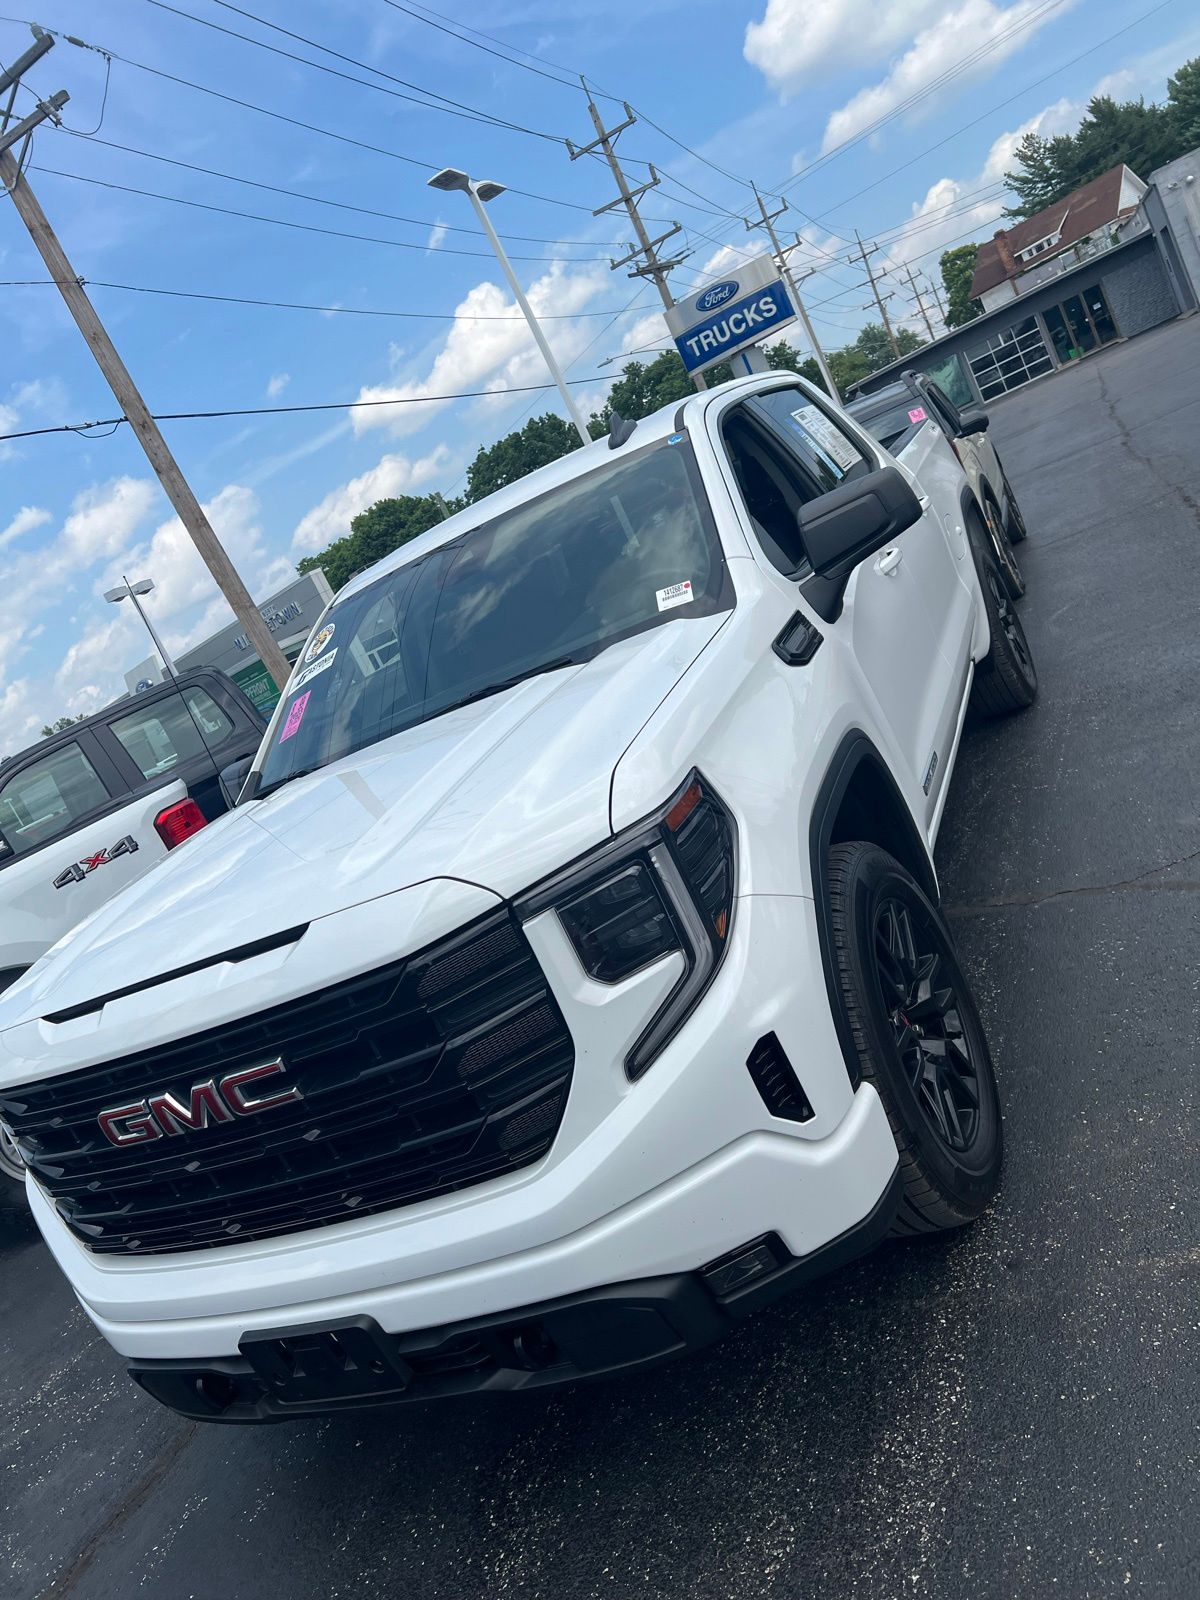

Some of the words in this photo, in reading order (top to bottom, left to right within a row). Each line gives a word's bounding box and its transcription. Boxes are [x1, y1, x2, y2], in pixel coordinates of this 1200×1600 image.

[686, 296, 777, 358] TRUCKS
[704, 285, 731, 308] Ford
[97, 1056, 305, 1148] GMC
